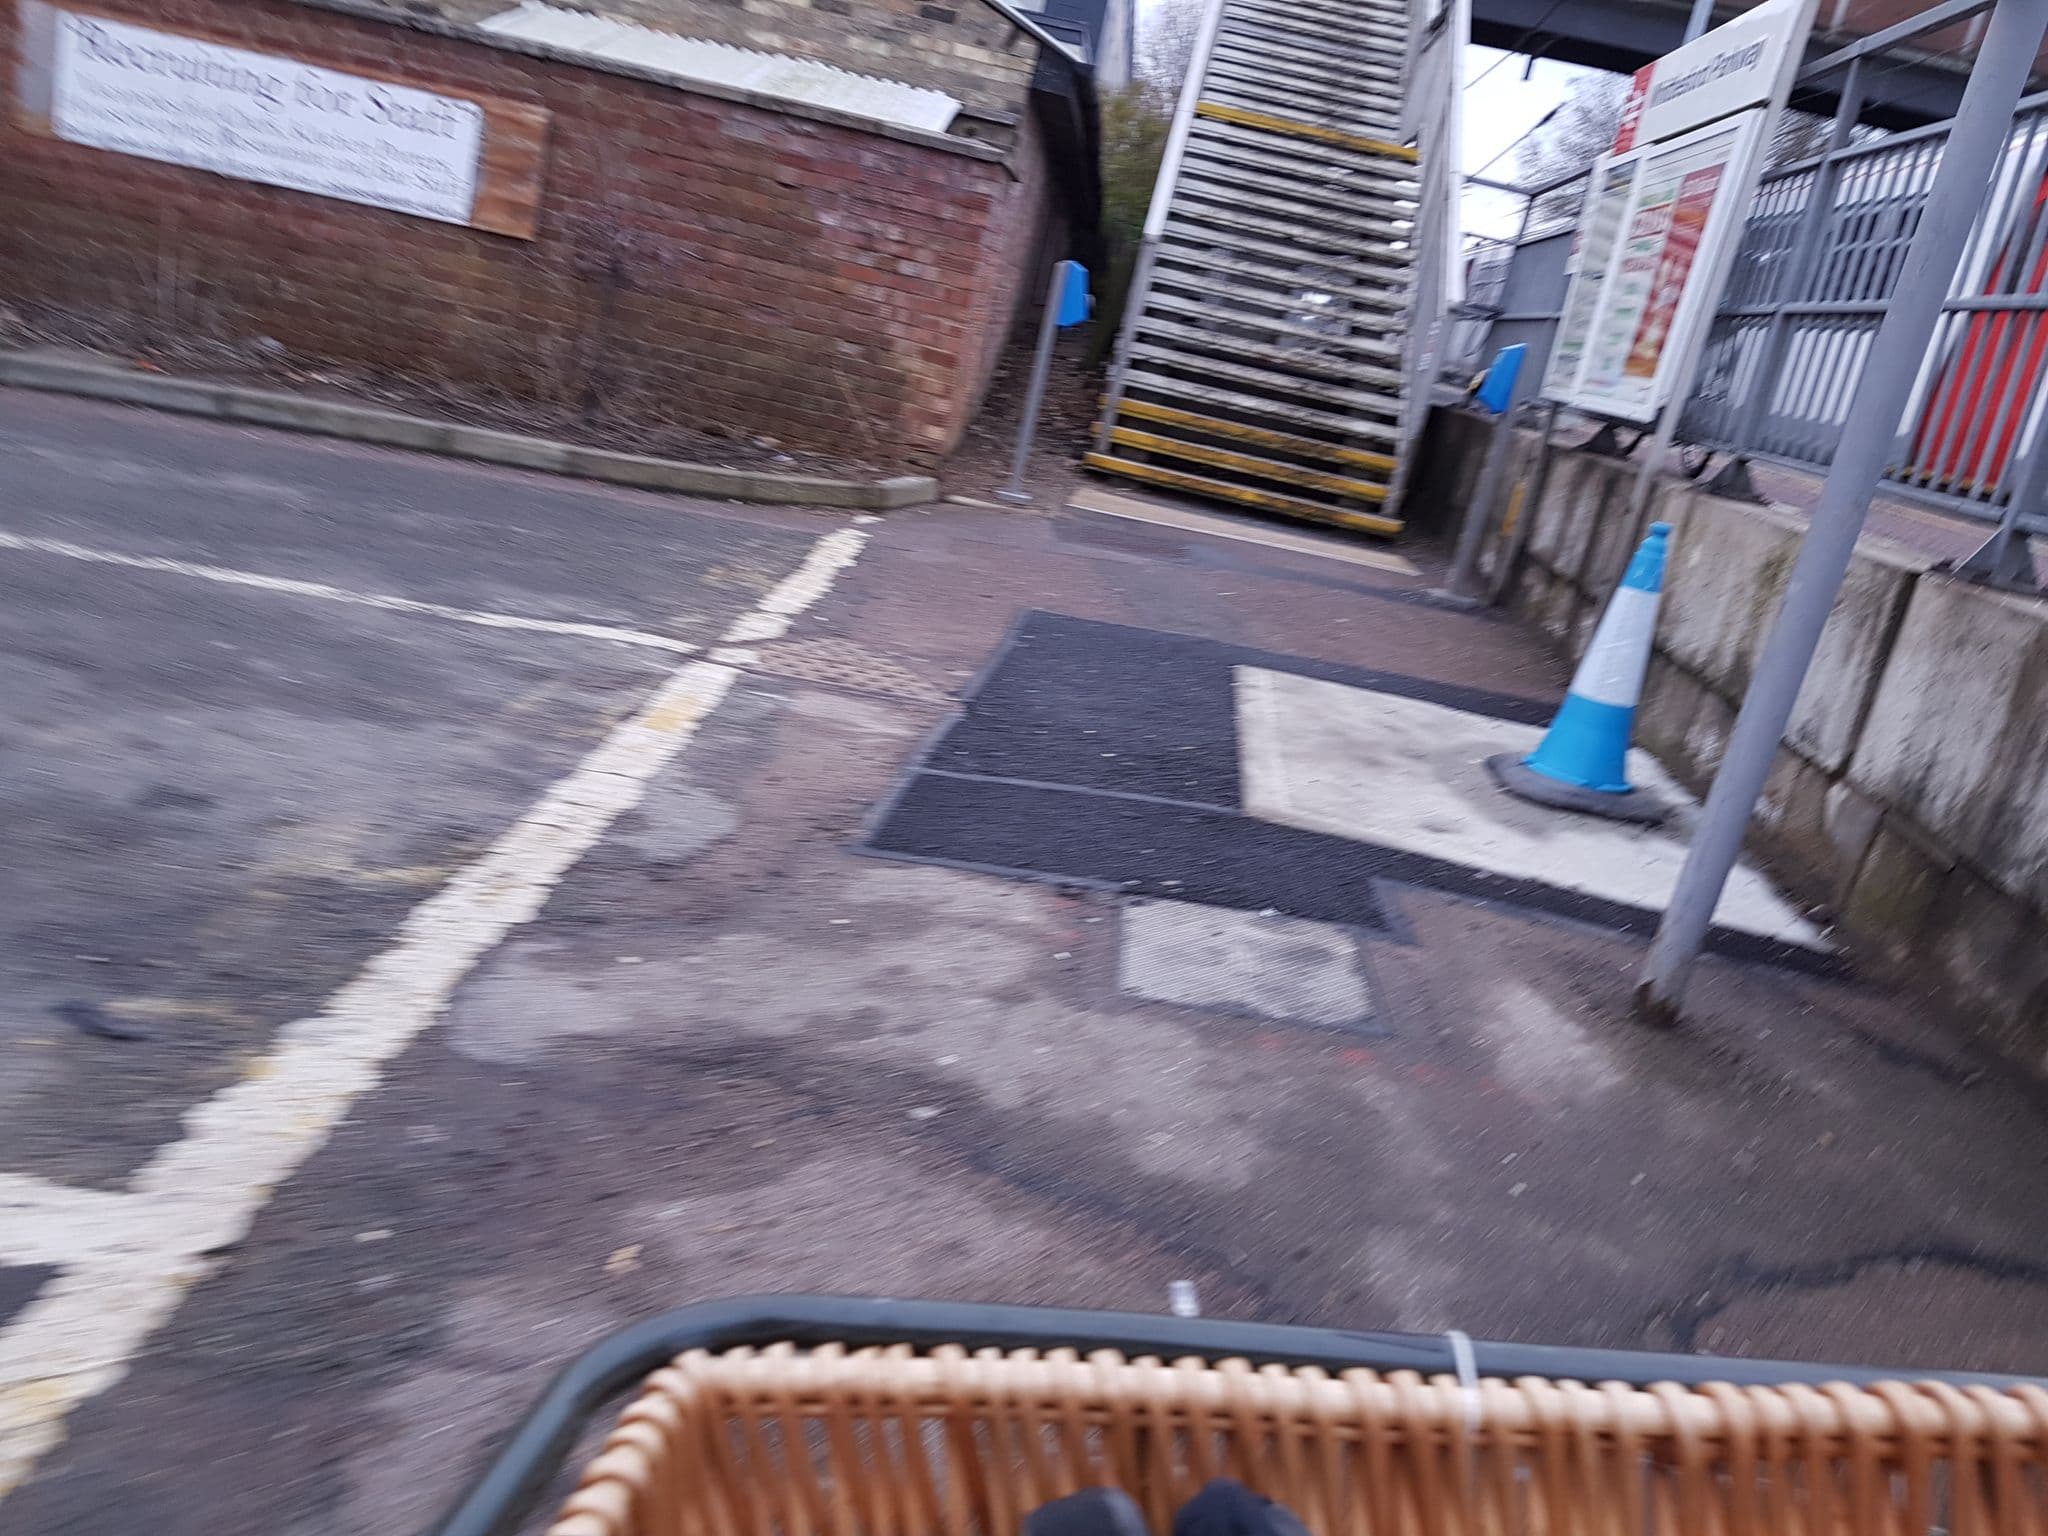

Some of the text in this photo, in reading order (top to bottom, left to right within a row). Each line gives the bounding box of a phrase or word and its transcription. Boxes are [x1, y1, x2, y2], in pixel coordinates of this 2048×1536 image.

[63, 15, 286, 114] Recruiting
[296, 68, 356, 120] for
[363, 82, 462, 142] Staff
